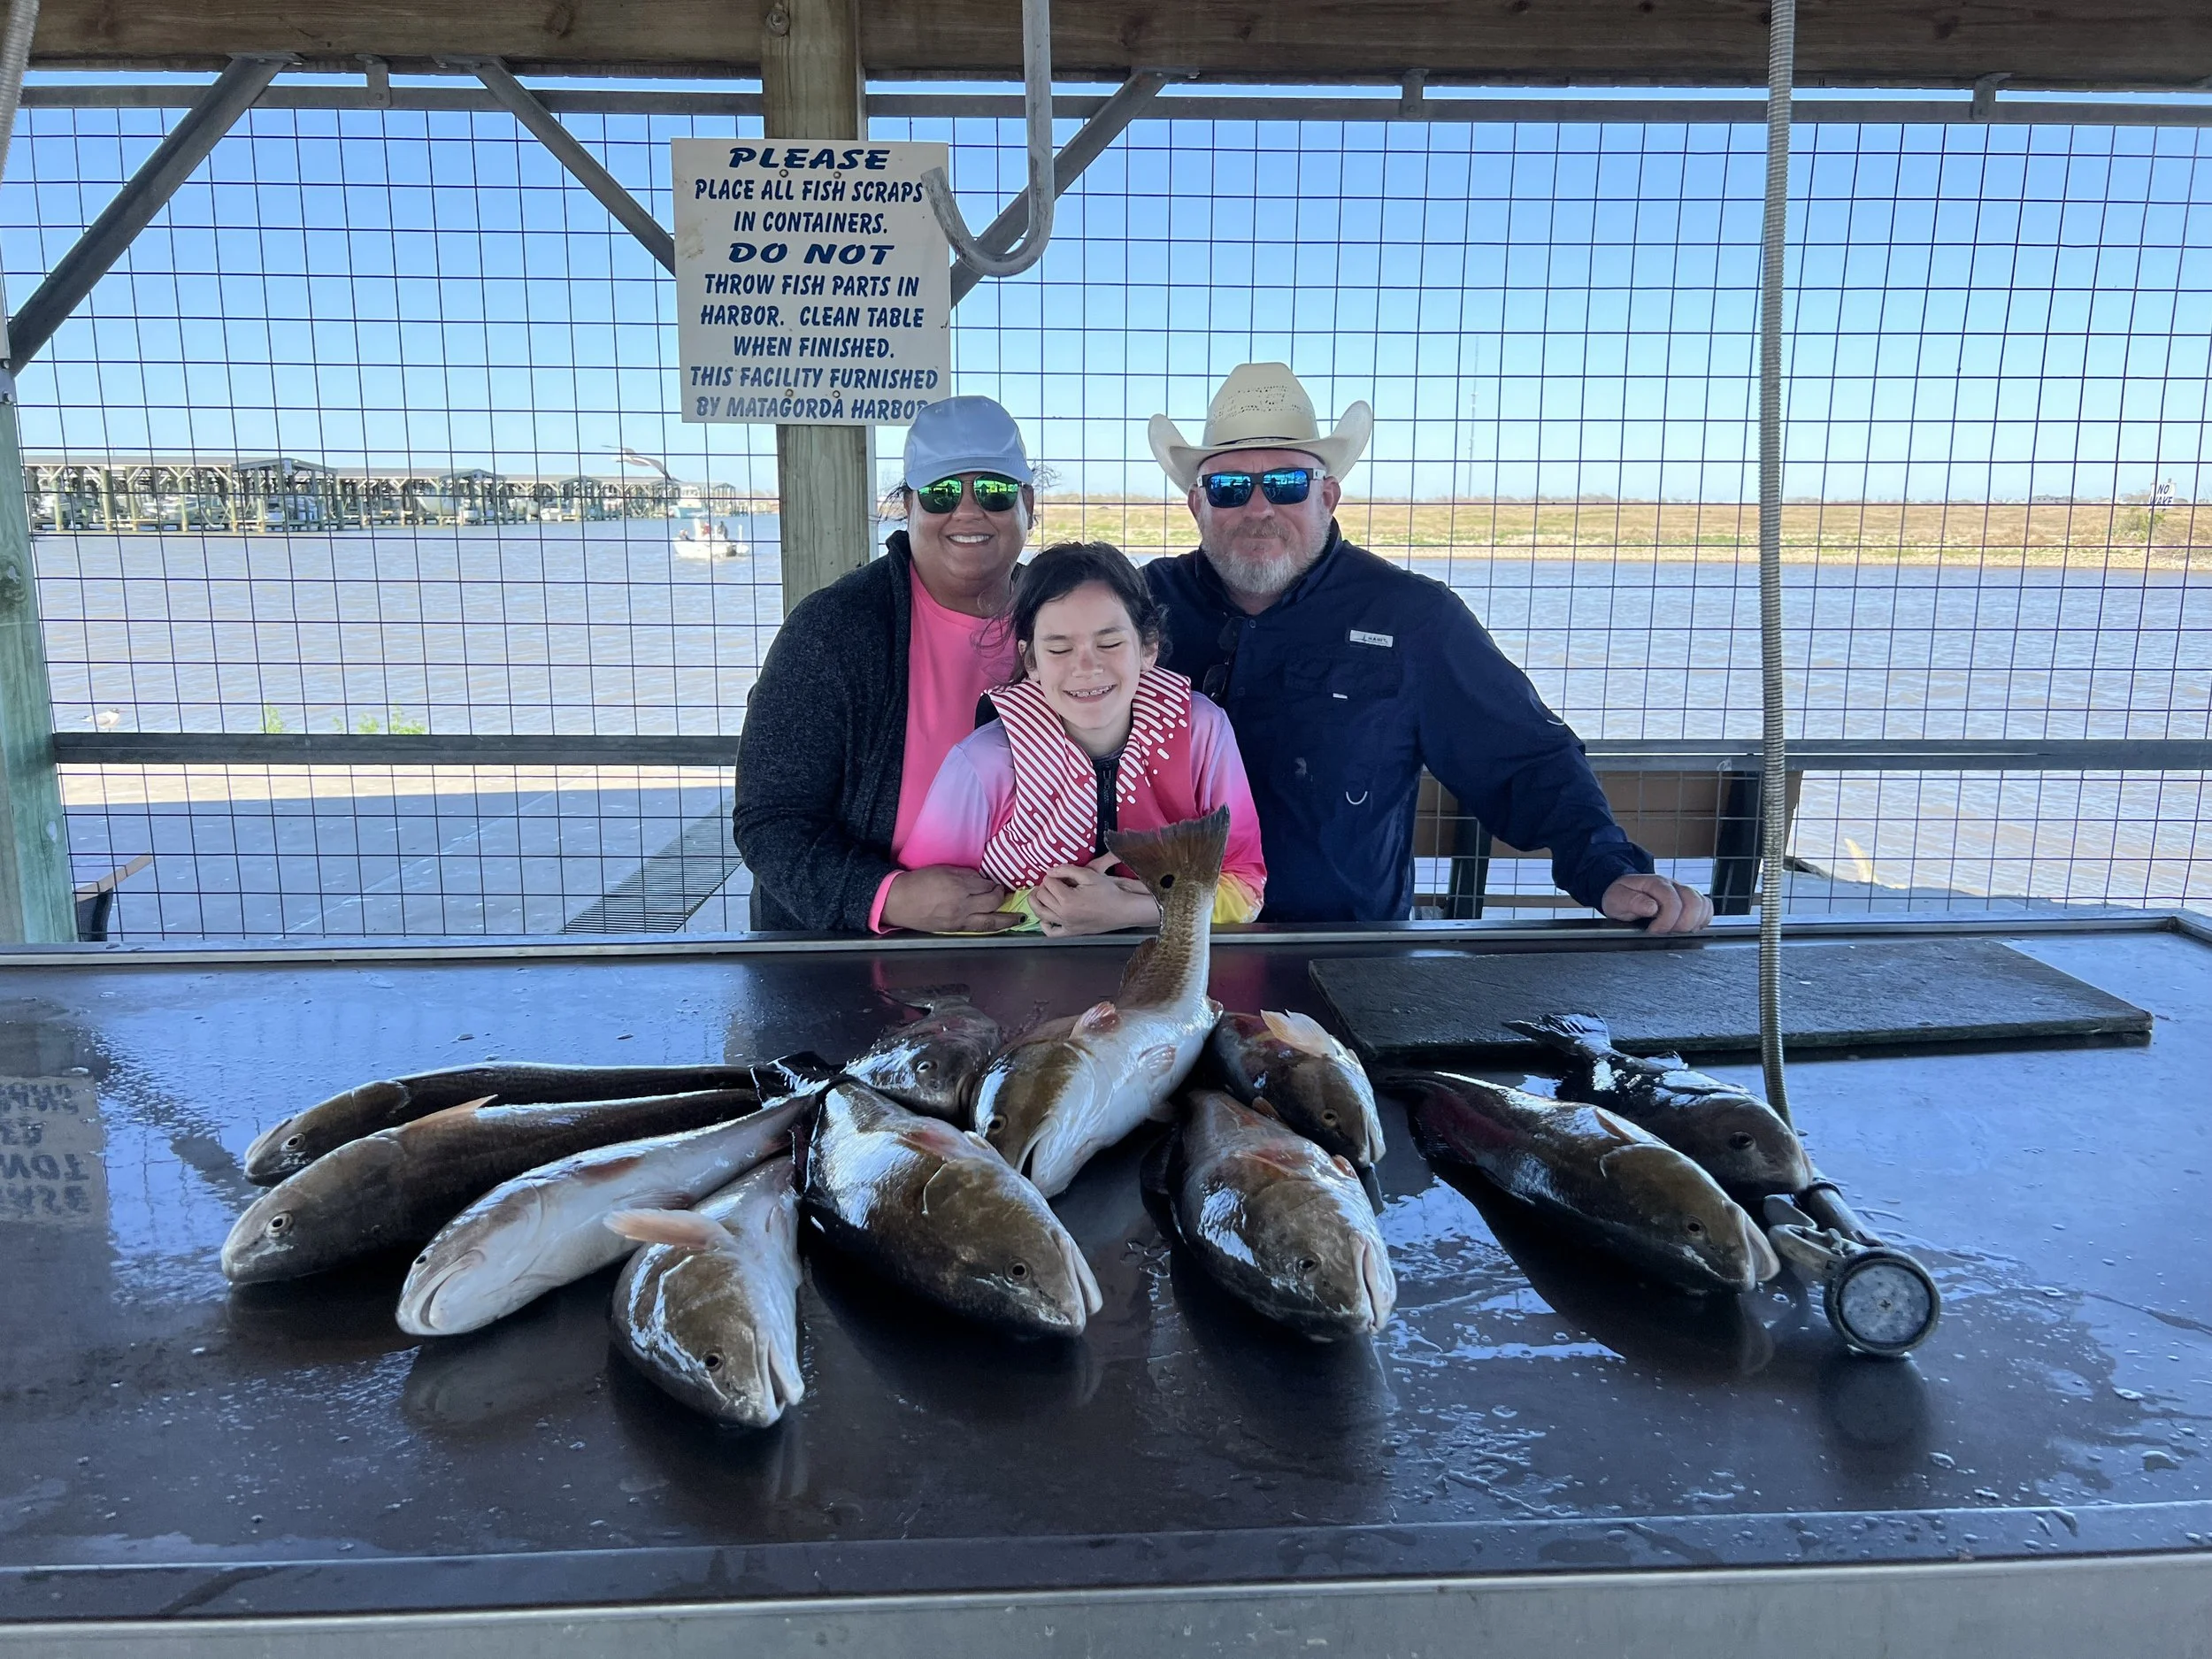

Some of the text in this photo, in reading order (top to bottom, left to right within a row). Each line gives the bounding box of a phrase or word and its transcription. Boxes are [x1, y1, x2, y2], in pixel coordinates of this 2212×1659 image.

[729, 147, 890, 170] PLEASE
[695, 179, 923, 203] PLACE ALL FISH SCRAPS
[733, 211, 887, 234] IN CONTAINERS.
[728, 242, 895, 265] DO NOT
[705, 273, 919, 297] THROW FISH PARTS IN
[701, 304, 925, 328] HARBOR. CLEAN TABLE
[733, 335, 895, 359] WHEN FINISHED.
[690, 365, 939, 390] THIS FACILITY FURNISHED
[696, 396, 718, 417] BY
[726, 396, 844, 419] MATAGORDA
[2157, 484, 2170, 495] NO
